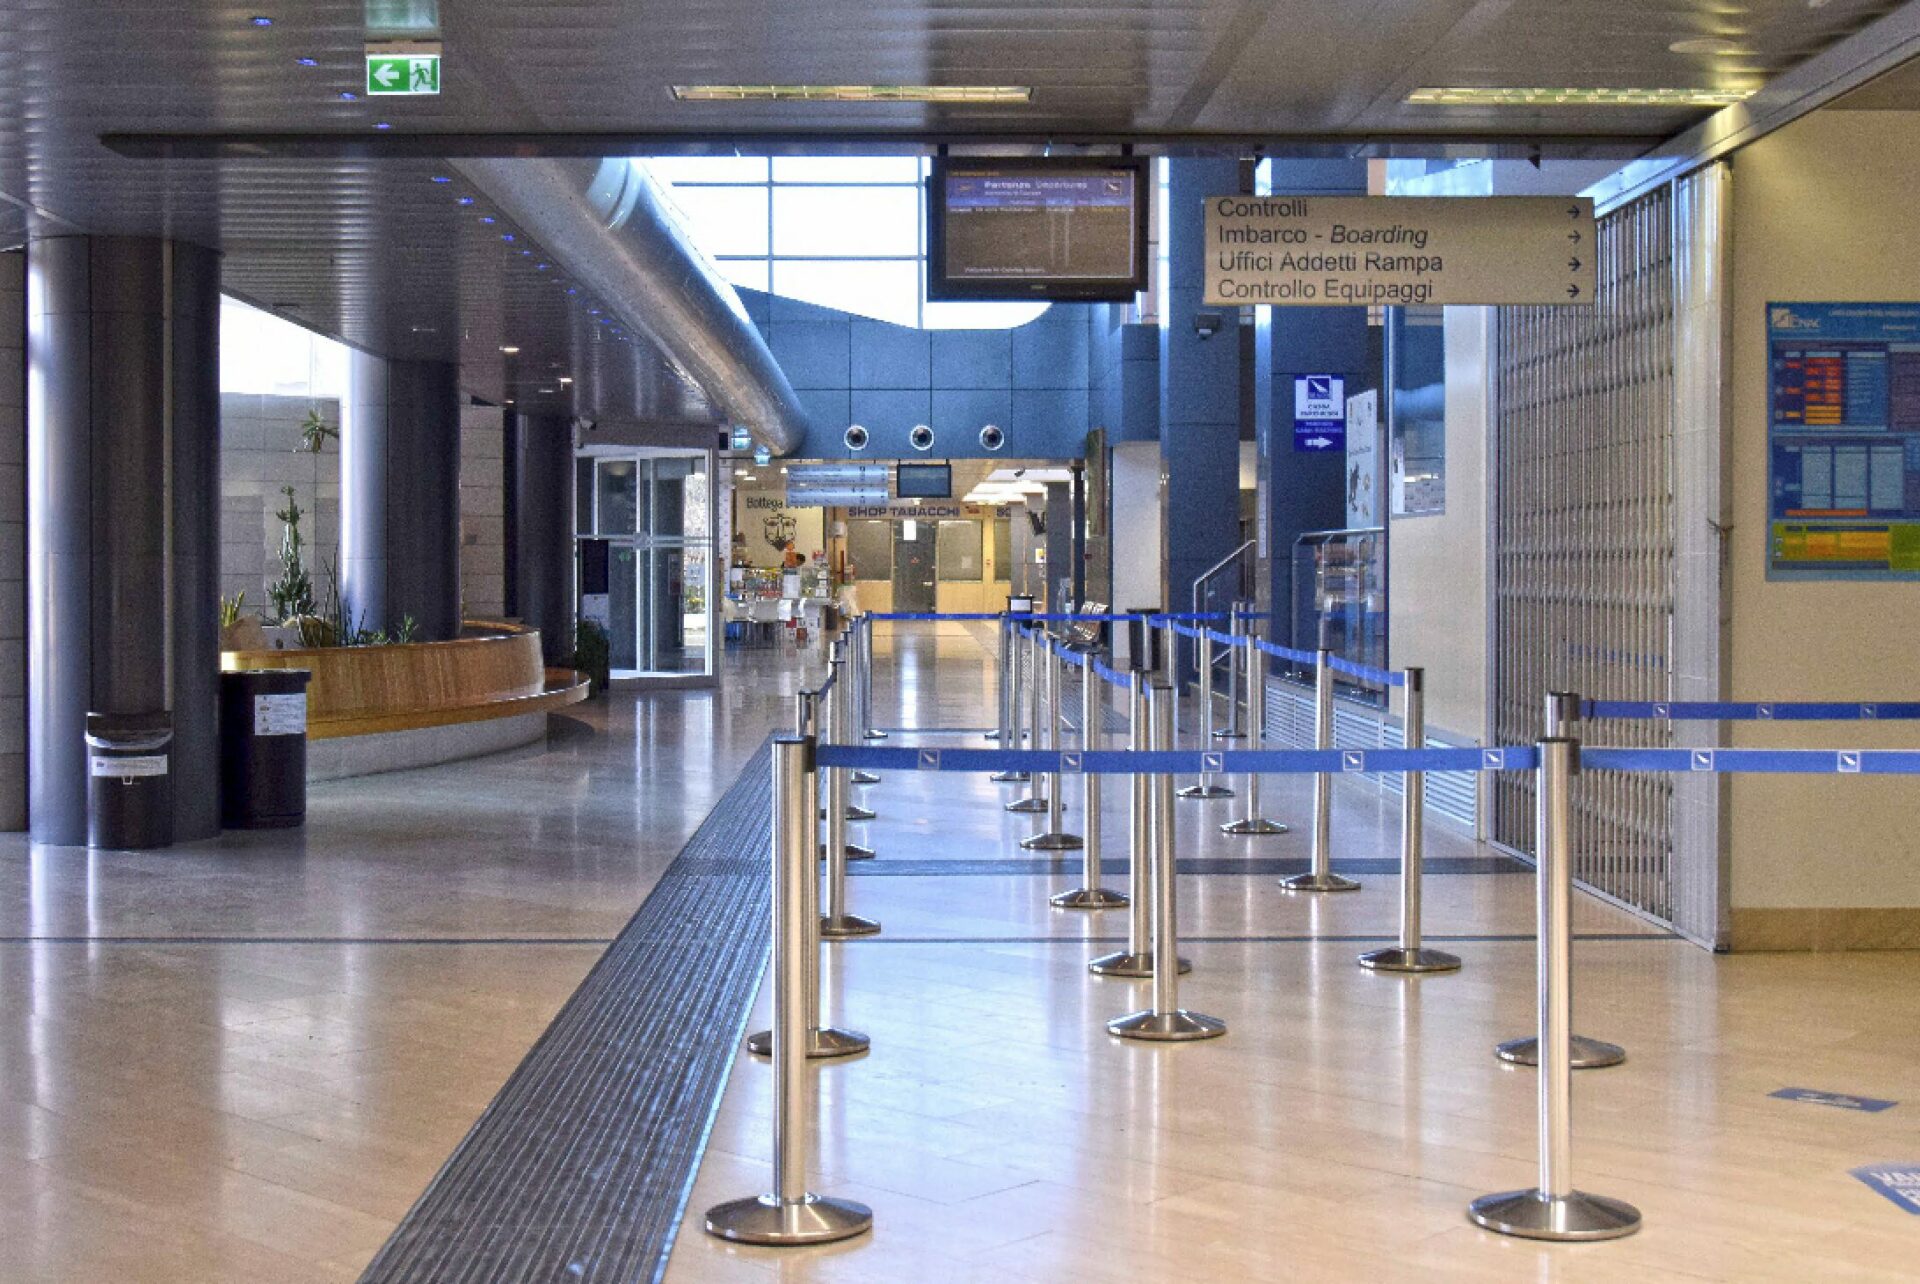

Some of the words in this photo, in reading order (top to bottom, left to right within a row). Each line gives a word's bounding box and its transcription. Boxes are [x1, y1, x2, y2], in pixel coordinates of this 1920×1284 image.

[1217, 199, 1308, 217] Controlli
[1218, 224, 1308, 244] Imbarco
[1330, 224, 1428, 249] Boarding
[1219, 251, 1272, 272] Uffici
[1280, 251, 1357, 272] Addetti
[1365, 251, 1443, 275] Rampa
[1218, 279, 1316, 299] Controllo
[1325, 279, 1433, 303] Equipaggi
[746, 496, 784, 512] Bottega
[848, 506, 887, 517] SHOP
[890, 506, 960, 517] TABACCHI
